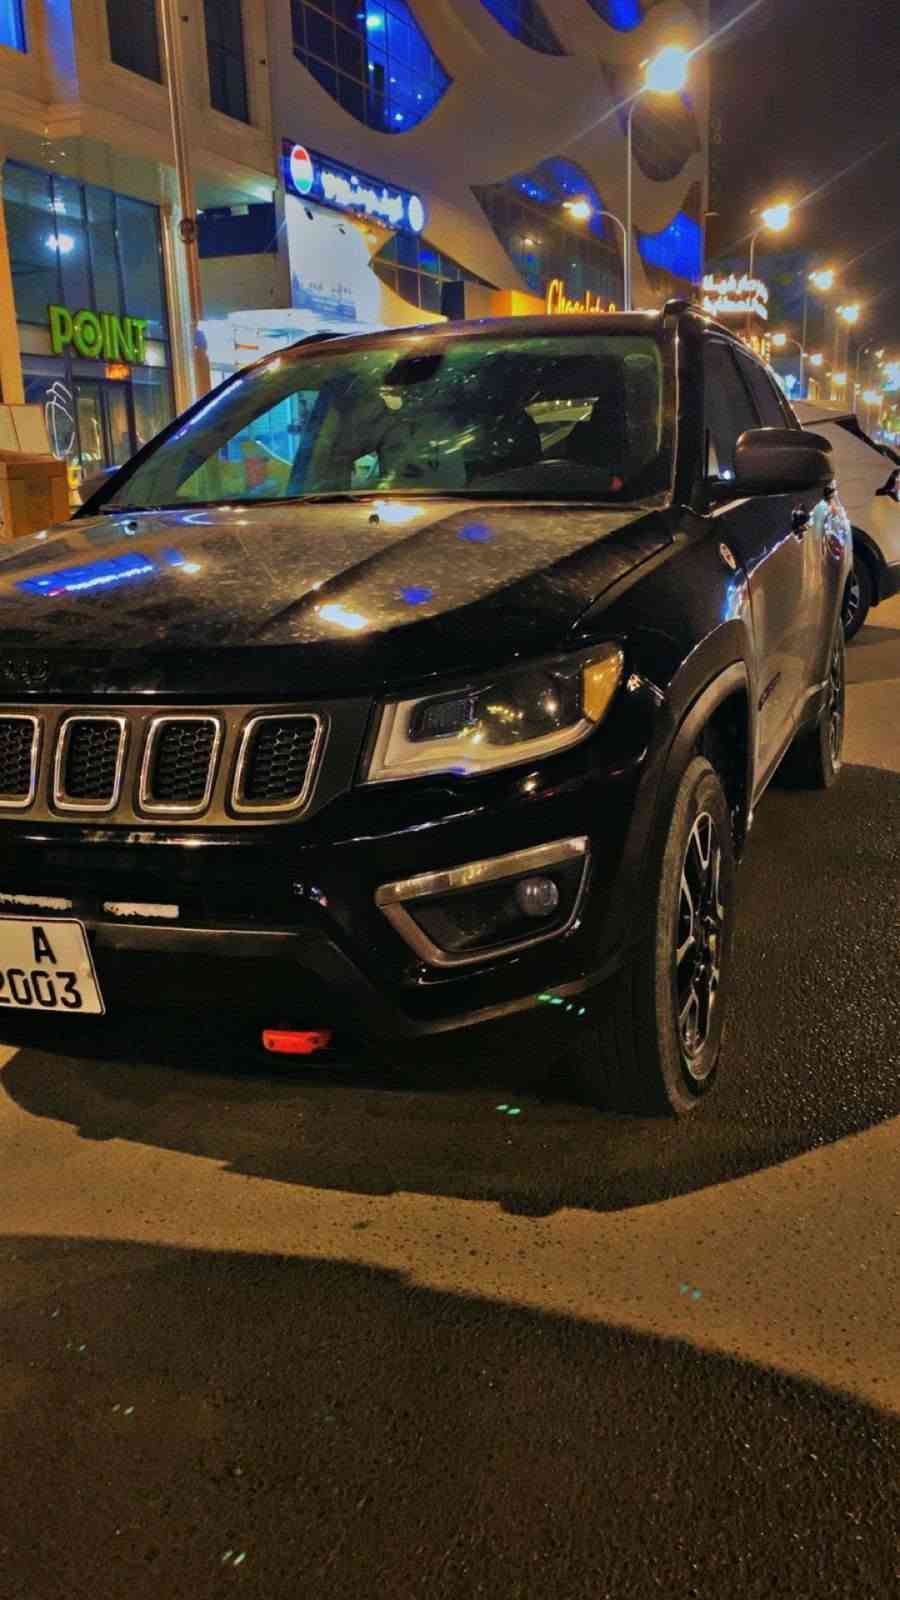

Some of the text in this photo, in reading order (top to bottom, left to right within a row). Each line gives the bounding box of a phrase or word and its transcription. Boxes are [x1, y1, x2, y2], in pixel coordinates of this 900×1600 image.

[547, 279, 605, 313] Chocolat
[48, 304, 148, 363] POINT
[32, 926, 57, 964] A
